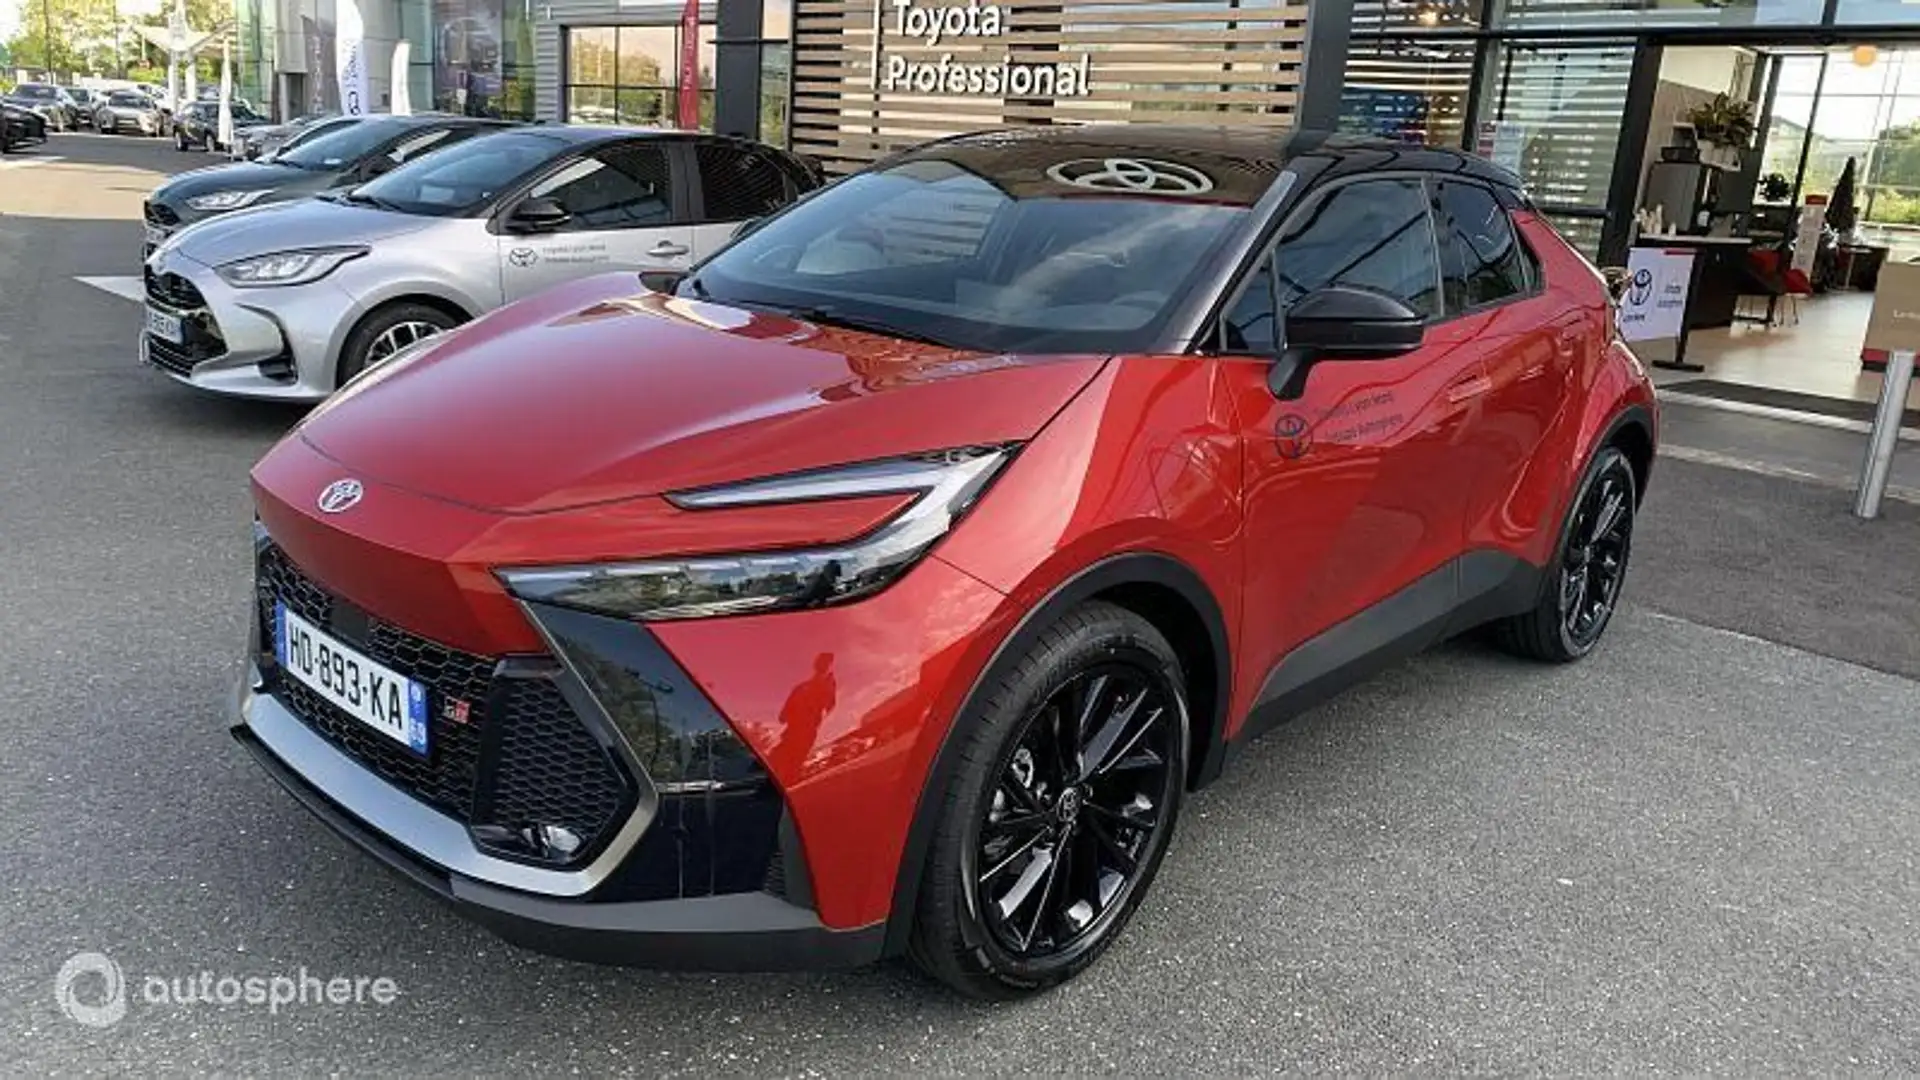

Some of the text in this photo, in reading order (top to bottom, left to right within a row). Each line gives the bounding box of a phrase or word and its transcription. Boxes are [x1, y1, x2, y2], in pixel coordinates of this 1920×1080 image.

[892, 0, 1001, 47] Toyota
[887, 53, 1091, 95] Professional
[289, 622, 403, 730] HD-893-KA
